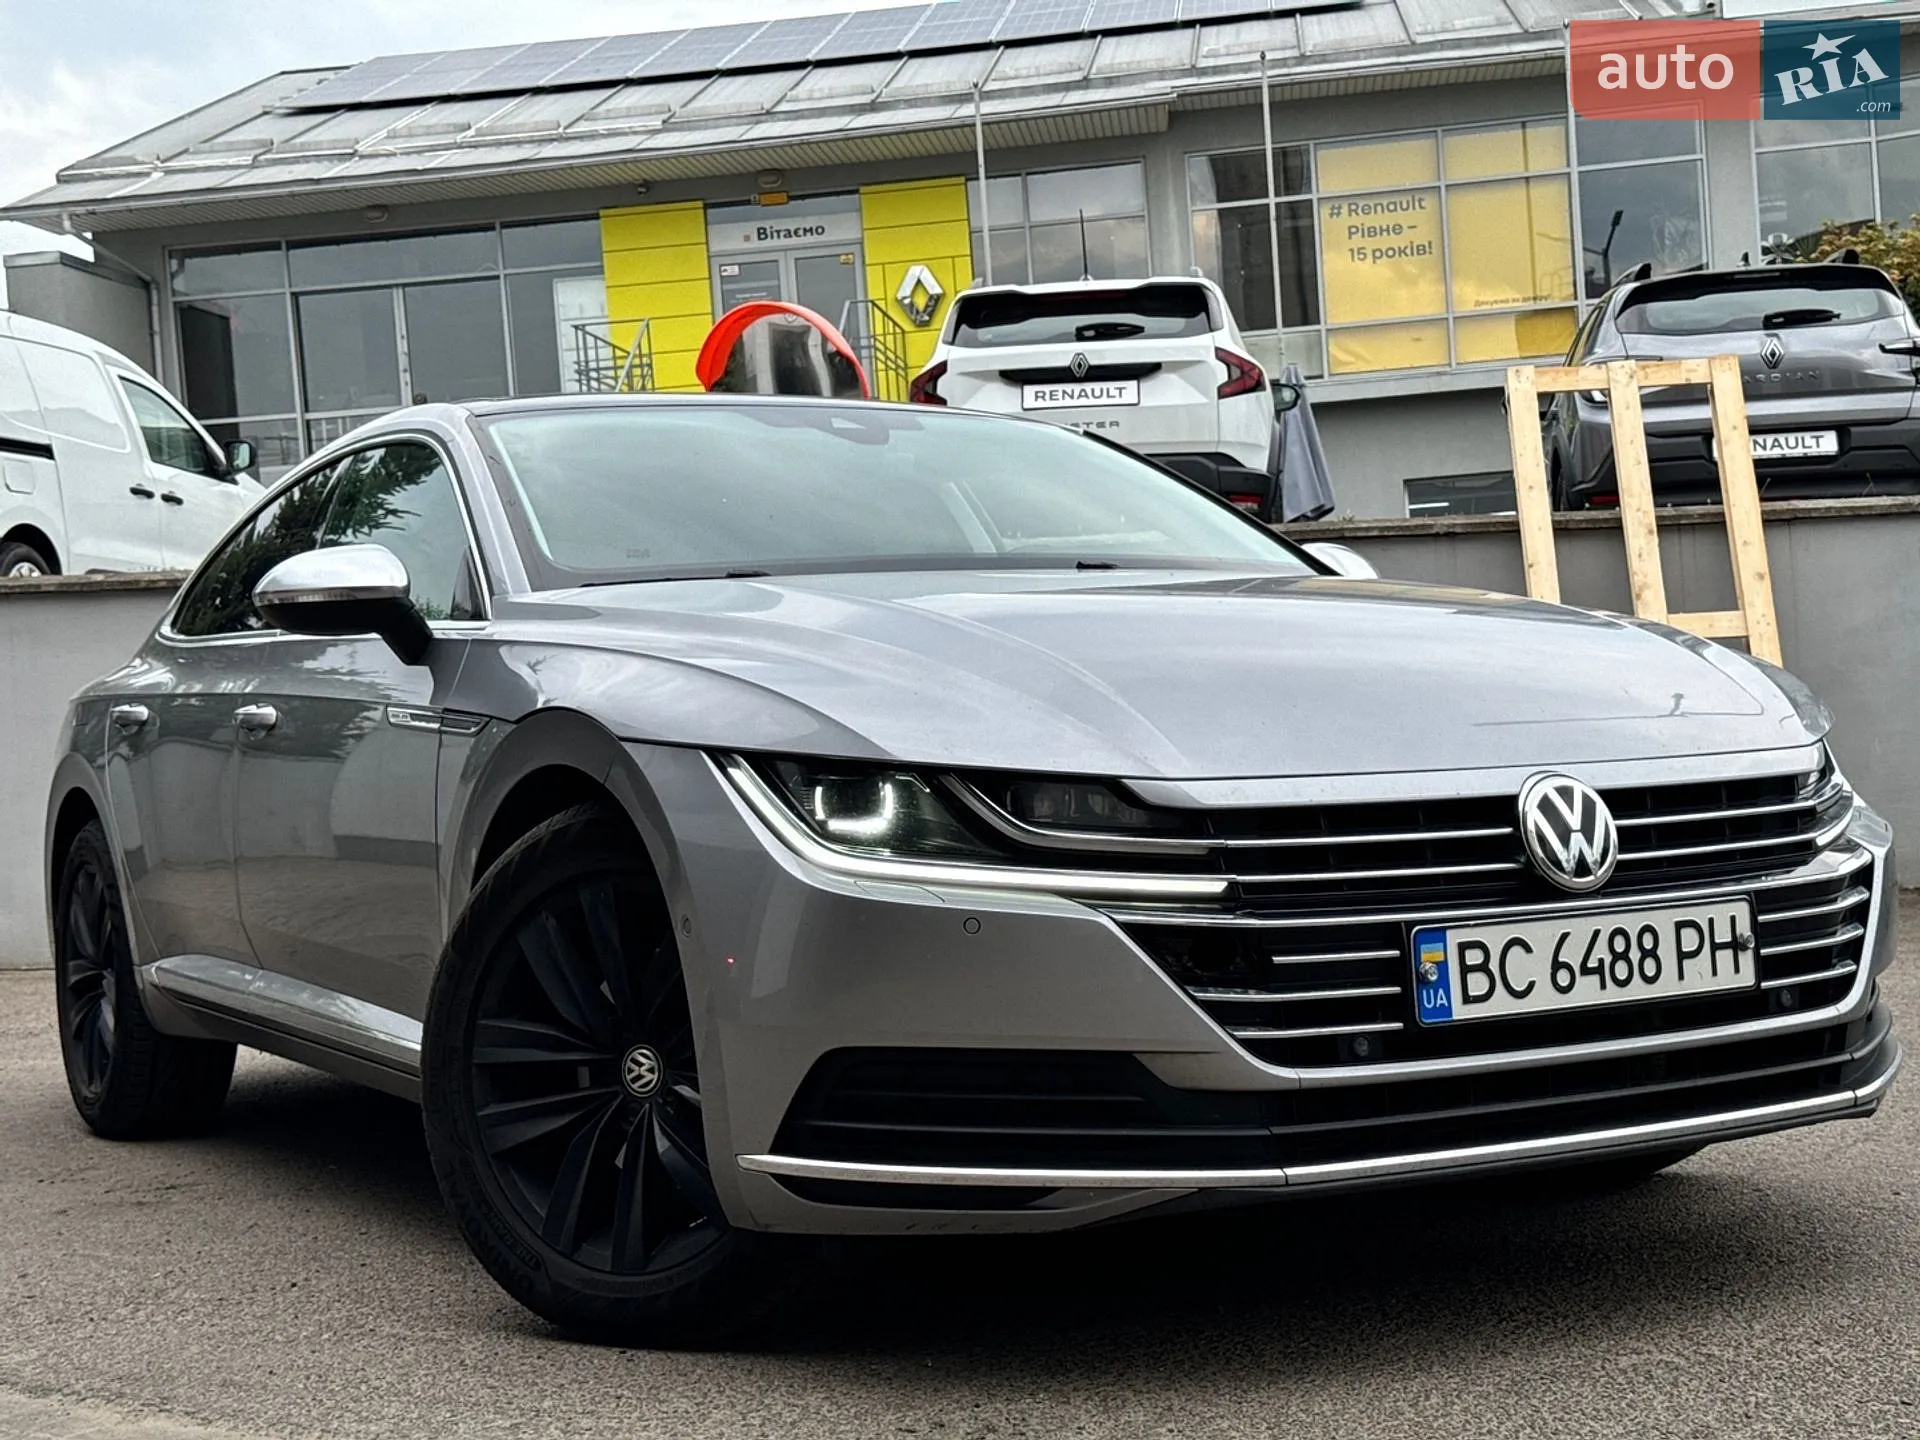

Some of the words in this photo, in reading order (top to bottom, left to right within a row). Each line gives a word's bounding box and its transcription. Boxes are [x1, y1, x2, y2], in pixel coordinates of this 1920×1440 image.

[1347, 195, 1427, 218] Renault
[756, 225, 826, 241] Вітаємо
[1347, 222, 1404, 241] Рівне
[1348, 246, 1368, 263] 15
[1371, 240, 1433, 264] років!
[1034, 386, 1128, 402] RENAULT
[1066, 420, 1120, 430] STER
[1752, 434, 1825, 453] NAULT
[1457, 936, 1537, 1005] BC
[1550, 923, 1663, 995] 6488
[1673, 913, 1742, 982] PH
[1423, 987, 1449, 1010] UA
